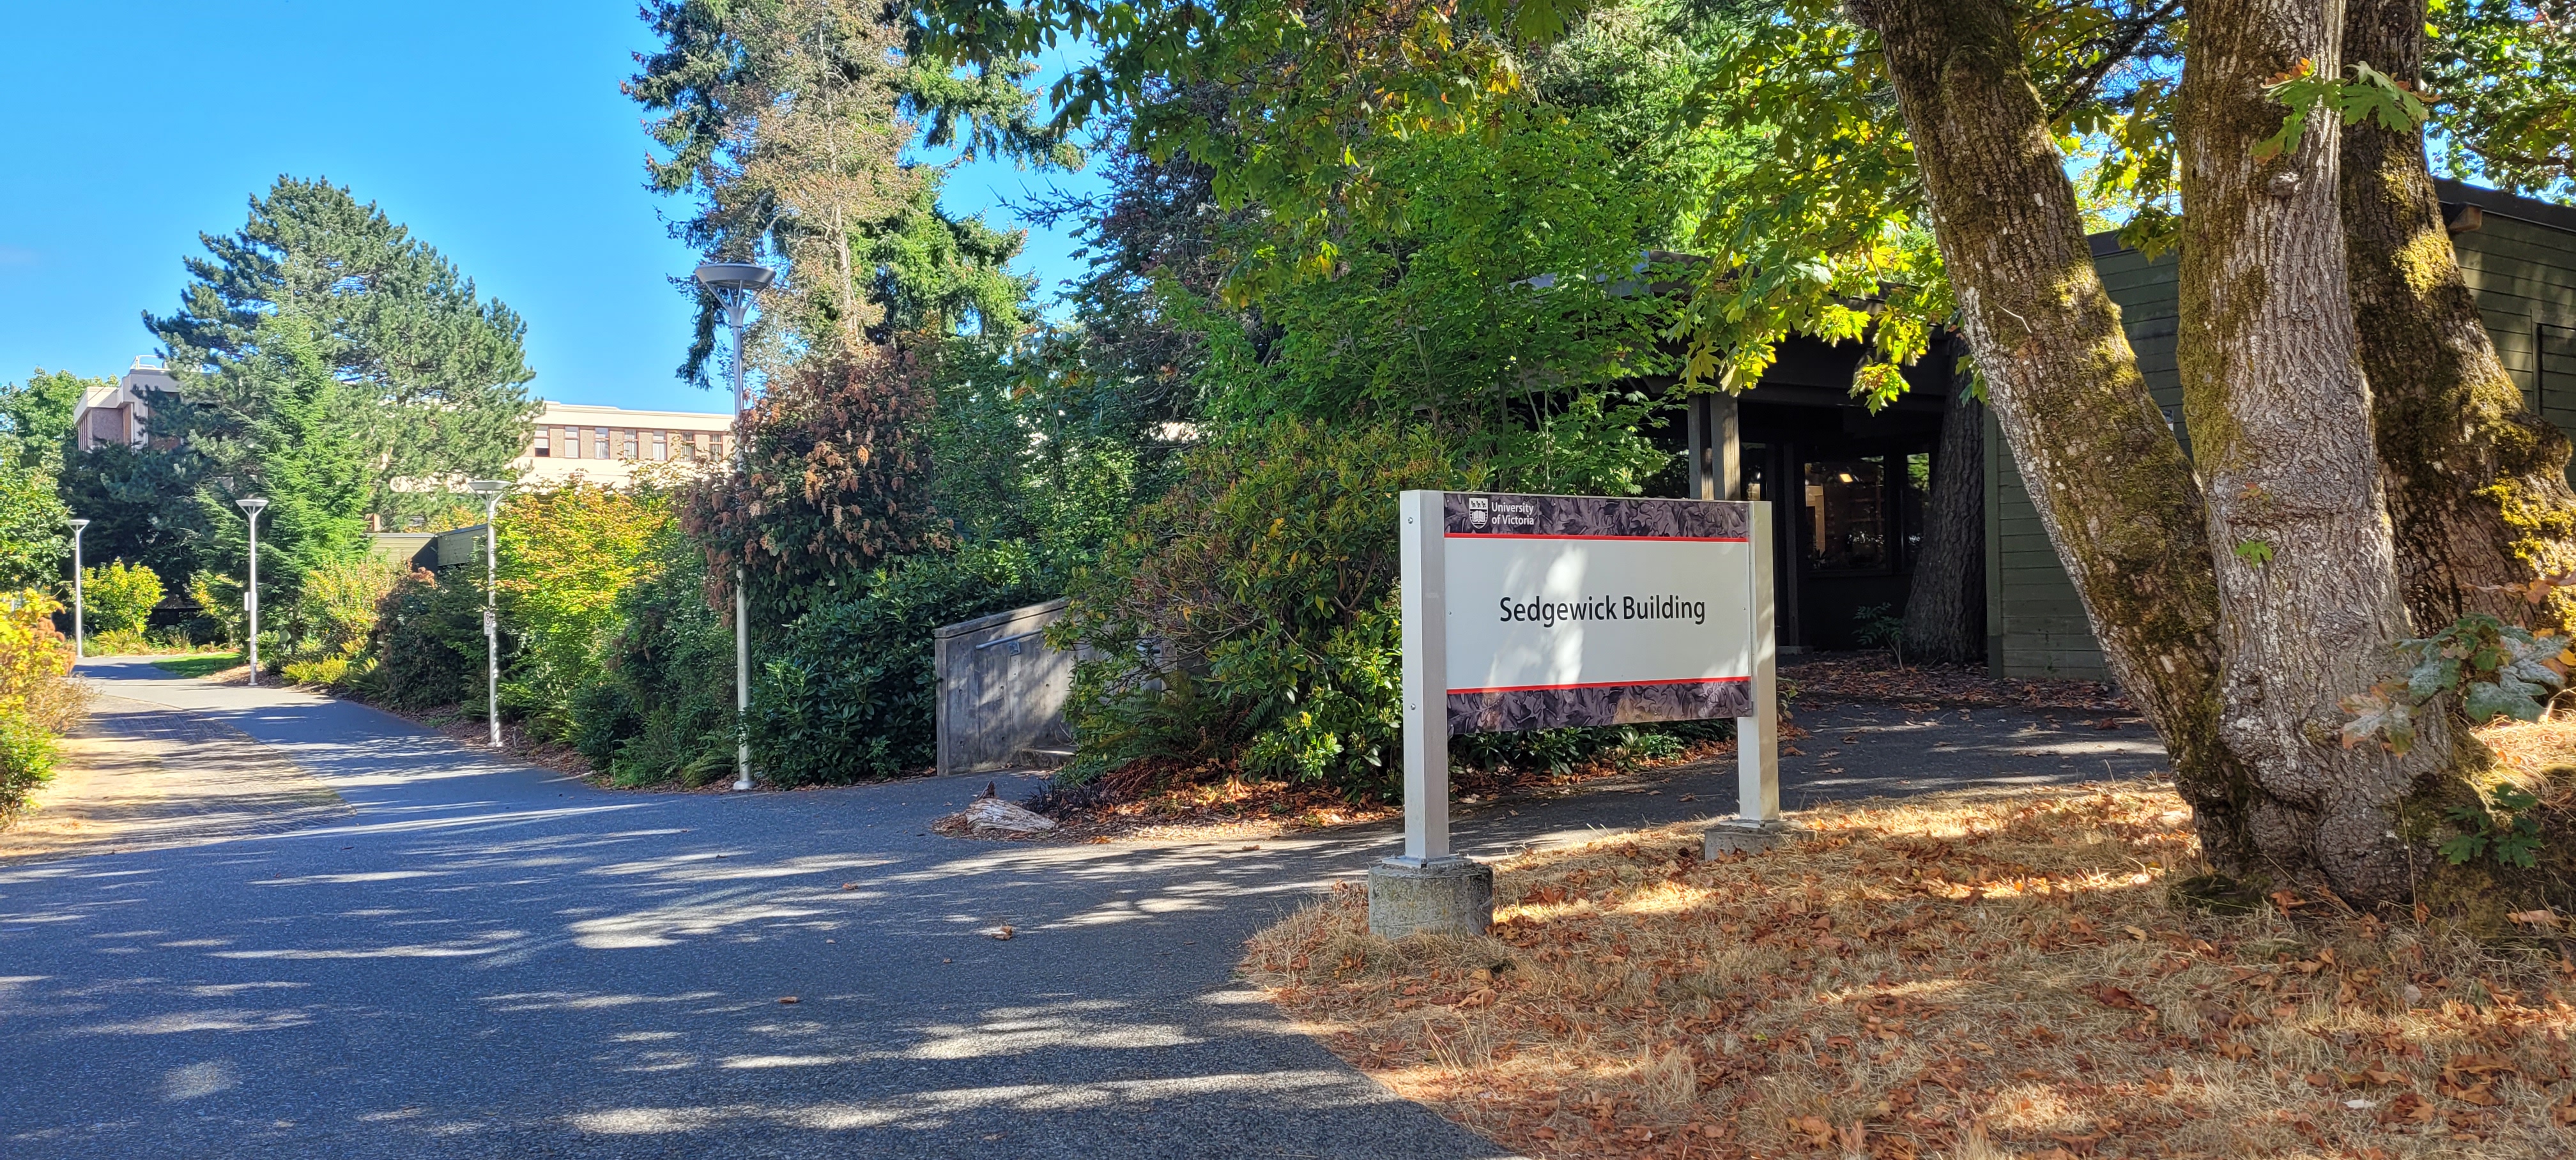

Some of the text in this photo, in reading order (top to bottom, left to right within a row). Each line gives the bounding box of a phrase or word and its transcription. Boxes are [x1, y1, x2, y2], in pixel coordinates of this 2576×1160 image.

[1491, 502, 1534, 515] University
[1491, 514, 1535, 525] of Victoria
[1499, 594, 1705, 628] Sedgewick Building
